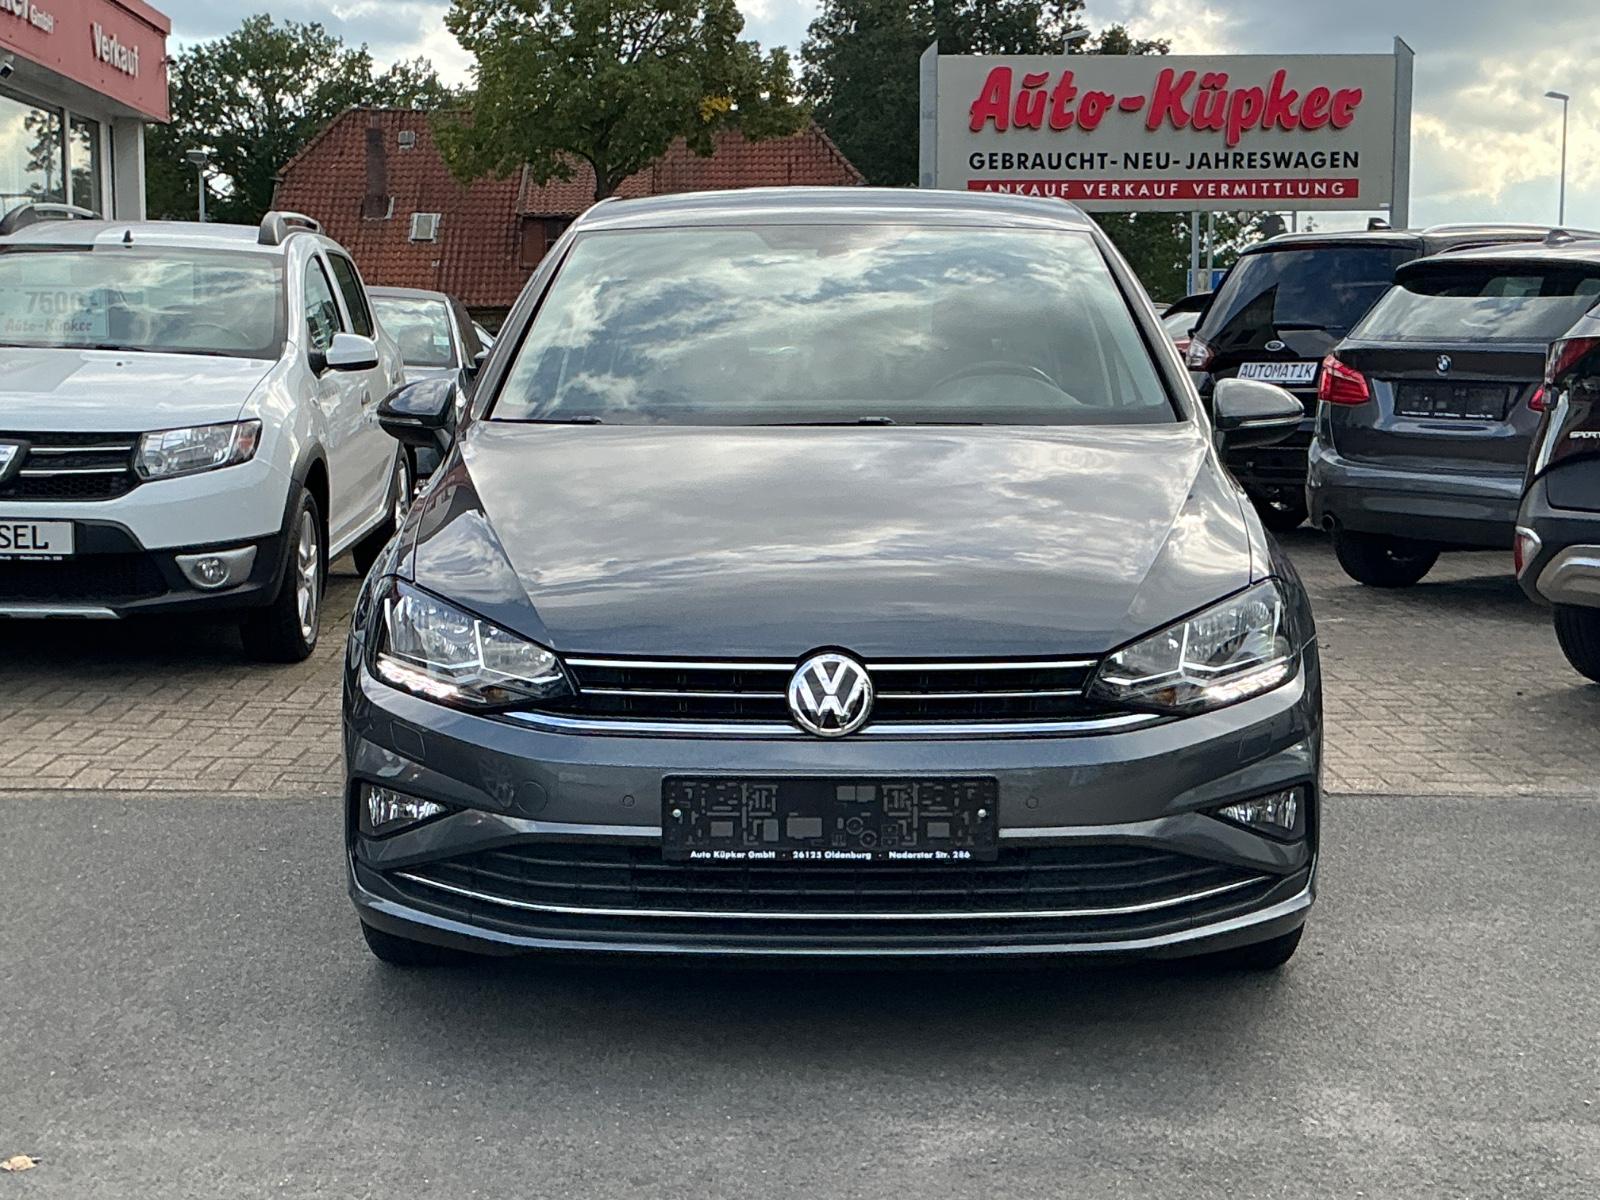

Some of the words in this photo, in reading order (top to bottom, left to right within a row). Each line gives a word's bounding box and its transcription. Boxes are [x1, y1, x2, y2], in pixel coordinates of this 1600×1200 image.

[92, 22, 140, 78] Verkauf
[984, 183, 1070, 197] ANKAUF
[1083, 183, 1179, 197] VERKAUF
[1192, 182, 1345, 196] VERMITTLUNG
[1240, 363, 1316, 378] AUTOMATIK
[690, 850, 711, 859] Auto
[713, 850, 746, 860] Küpker
[748, 850, 776, 859] GmbH
[824, 850, 872, 860] Oldenburg
[935, 850, 951, 859] Str.
[952, 850, 971, 859] 286
